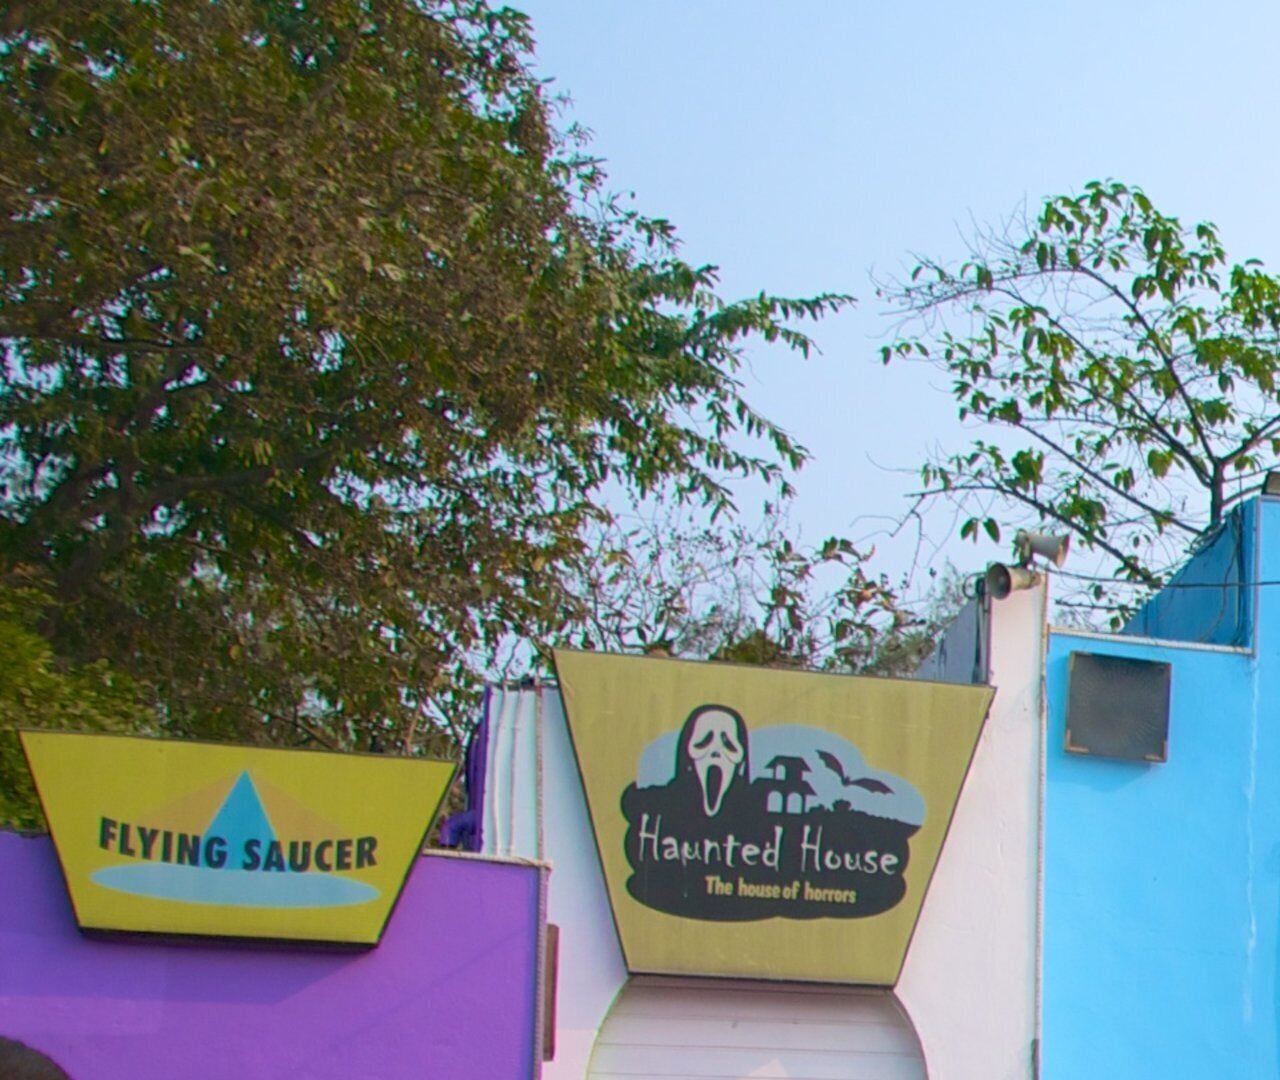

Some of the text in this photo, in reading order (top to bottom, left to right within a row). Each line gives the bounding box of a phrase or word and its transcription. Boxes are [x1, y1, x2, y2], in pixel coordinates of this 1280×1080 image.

[99, 816, 378, 872] FLYING SAUCER
[638, 813, 899, 876] Haunted House
[705, 875, 856, 904] The house of horrors
